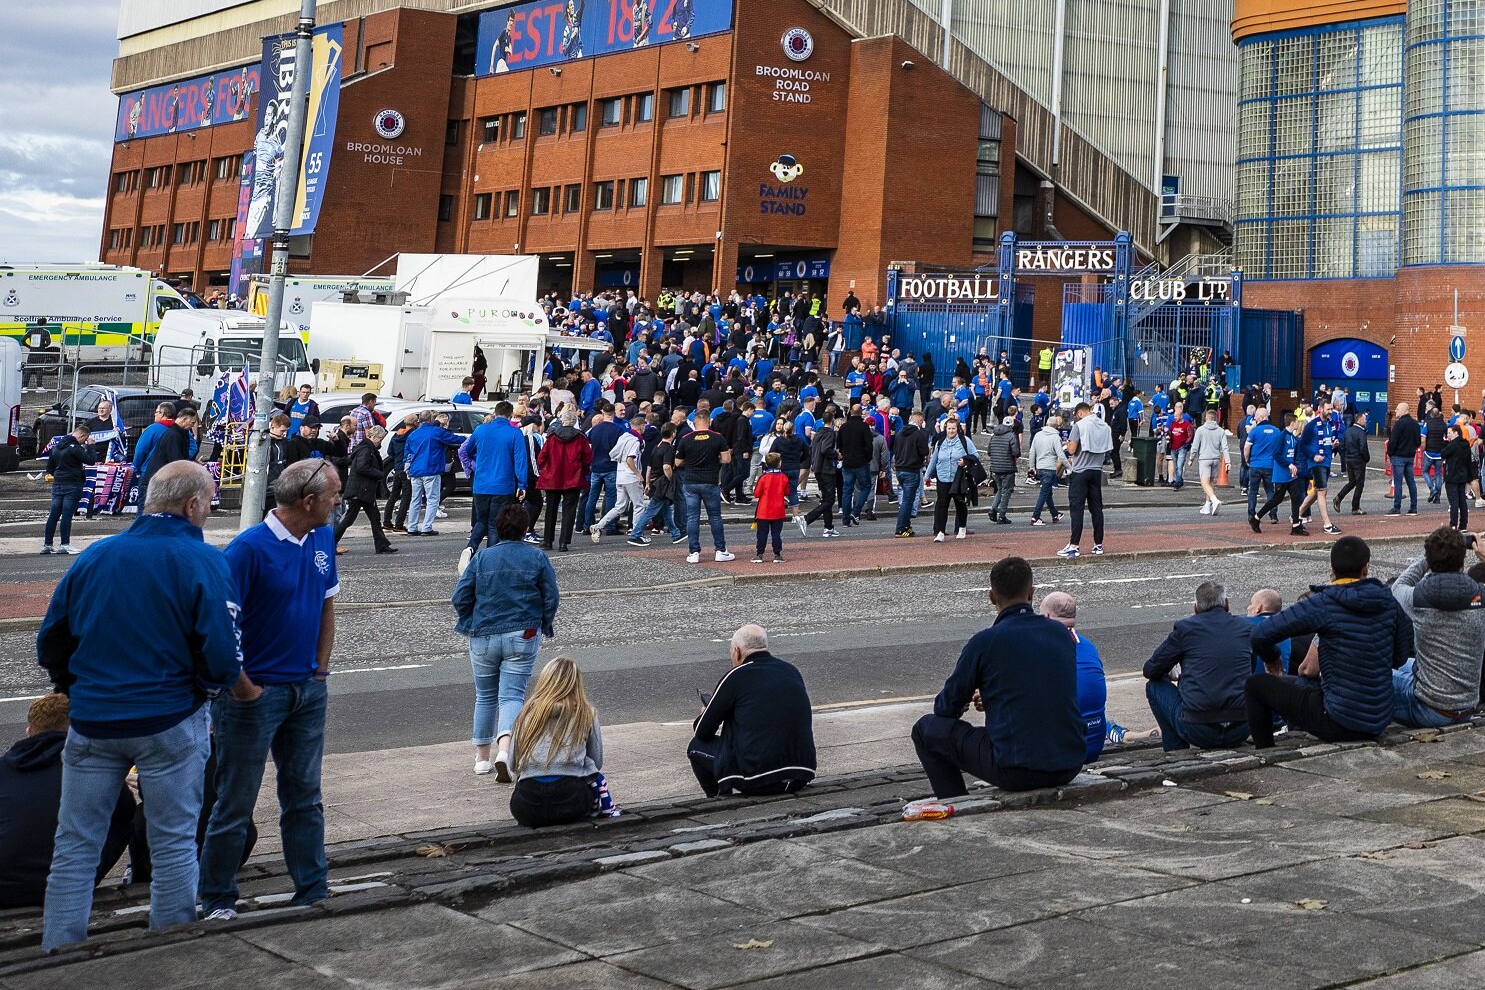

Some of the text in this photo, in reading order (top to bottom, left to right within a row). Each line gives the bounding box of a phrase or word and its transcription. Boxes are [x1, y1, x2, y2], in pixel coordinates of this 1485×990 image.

[755, 65, 831, 82] BROOMLOAN
[776, 79, 810, 92] ROAD
[772, 91, 812, 104] STAND
[120, 80, 214, 136] RANGERS
[346, 142, 422, 157] BROOMLOAN
[308, 151, 324, 175] 55
[364, 153, 404, 165] HOUSE
[759, 183, 809, 200] FAMILY
[759, 200, 807, 217] STAND
[1018, 249, 1114, 270] RANGERS
[28, 274, 118, 282] EMERGENCY AMBULANCE
[900, 278, 999, 300] FOOTBALL
[1130, 279, 1231, 302] CLUB LTD.
[48, 315, 92, 323] Ambulance
[93, 315, 122, 323] Service
[467, 308, 511, 319] PURO
